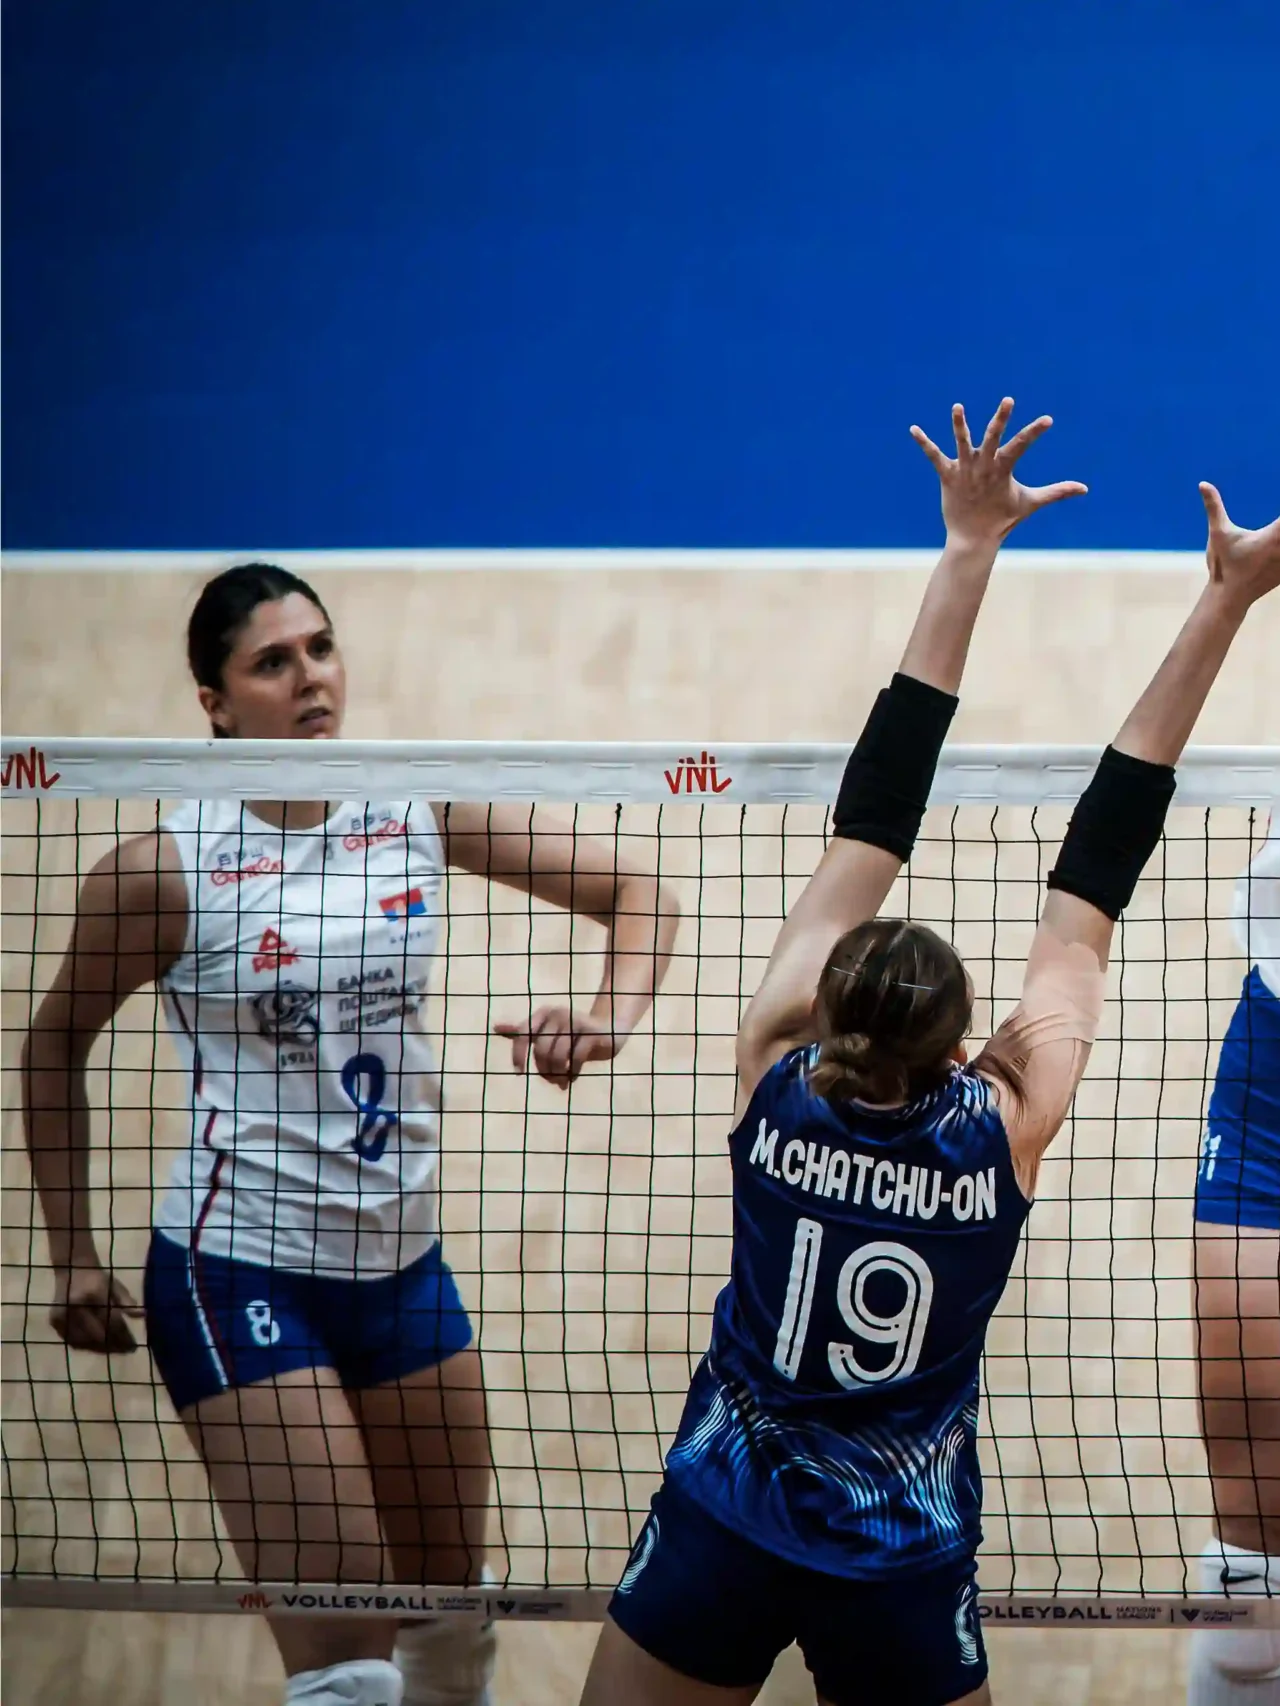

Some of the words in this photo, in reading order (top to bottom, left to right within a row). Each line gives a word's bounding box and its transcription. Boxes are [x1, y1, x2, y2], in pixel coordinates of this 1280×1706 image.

[341, 1052, 397, 1162] 8
[749, 1117, 997, 1221] M.CHATCHU-ON
[245, 1299, 281, 1347] 8
[773, 1217, 934, 1391] 19
[282, 1594, 433, 1612] VOLLEYBALL
[976, 1604, 1112, 1621] OLLEYBALL
